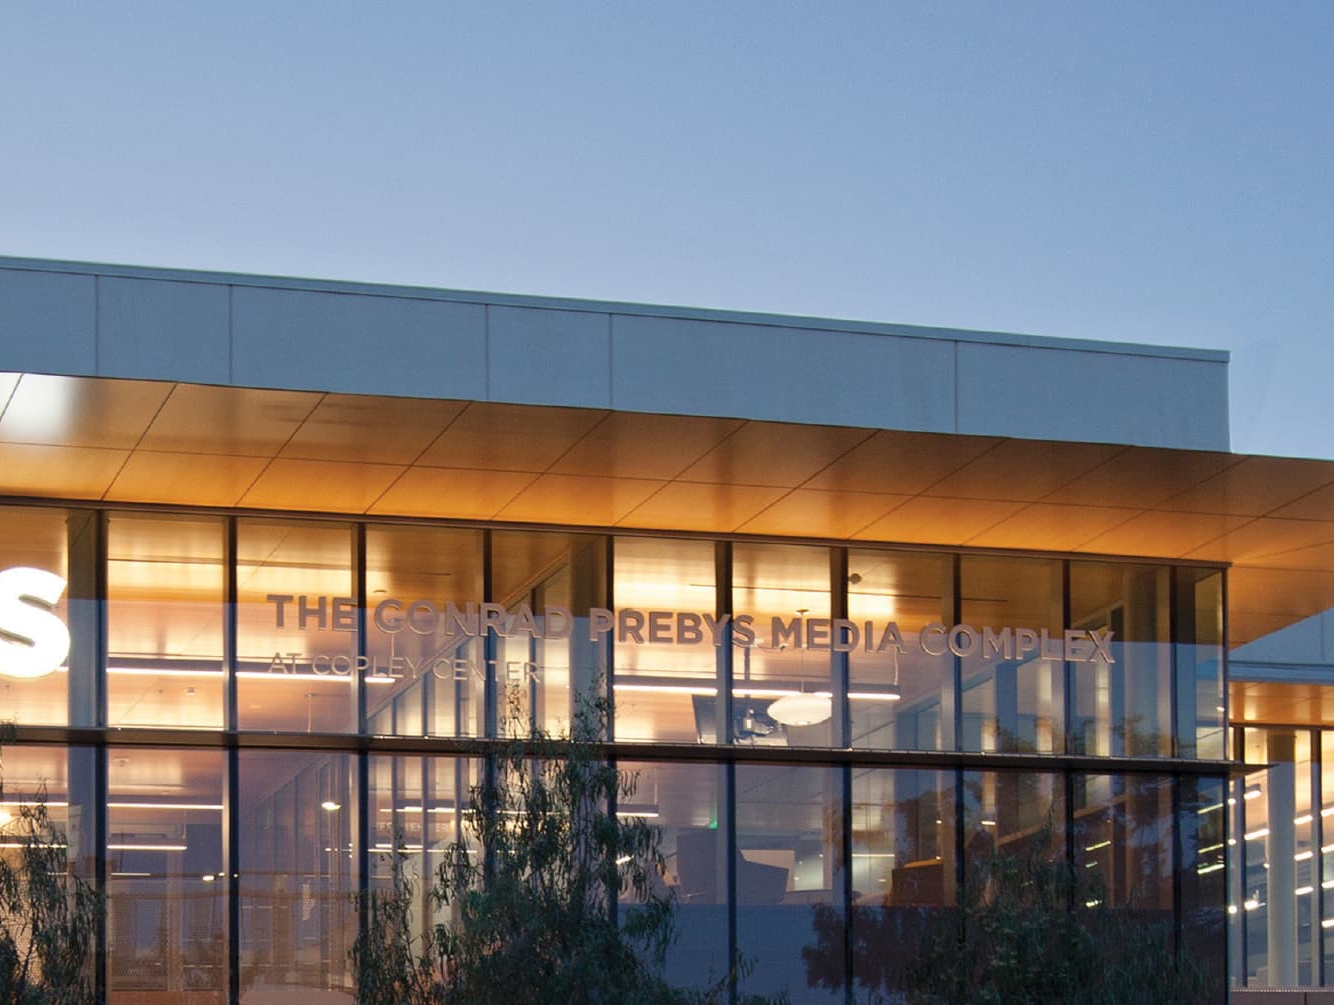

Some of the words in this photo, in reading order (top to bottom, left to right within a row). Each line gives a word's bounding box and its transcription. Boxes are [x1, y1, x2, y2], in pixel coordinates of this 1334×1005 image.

[267, 595, 359, 632] THE
[374, 598, 573, 640] CONRAD
[590, 607, 756, 647] PREBYS
[771, 616, 908, 654] MEDIA
[919, 622, 1116, 665] COMPLEX
[268, 652, 303, 675] AT
[312, 654, 424, 679] COPLEY
[433, 658, 541, 684] CENTER
